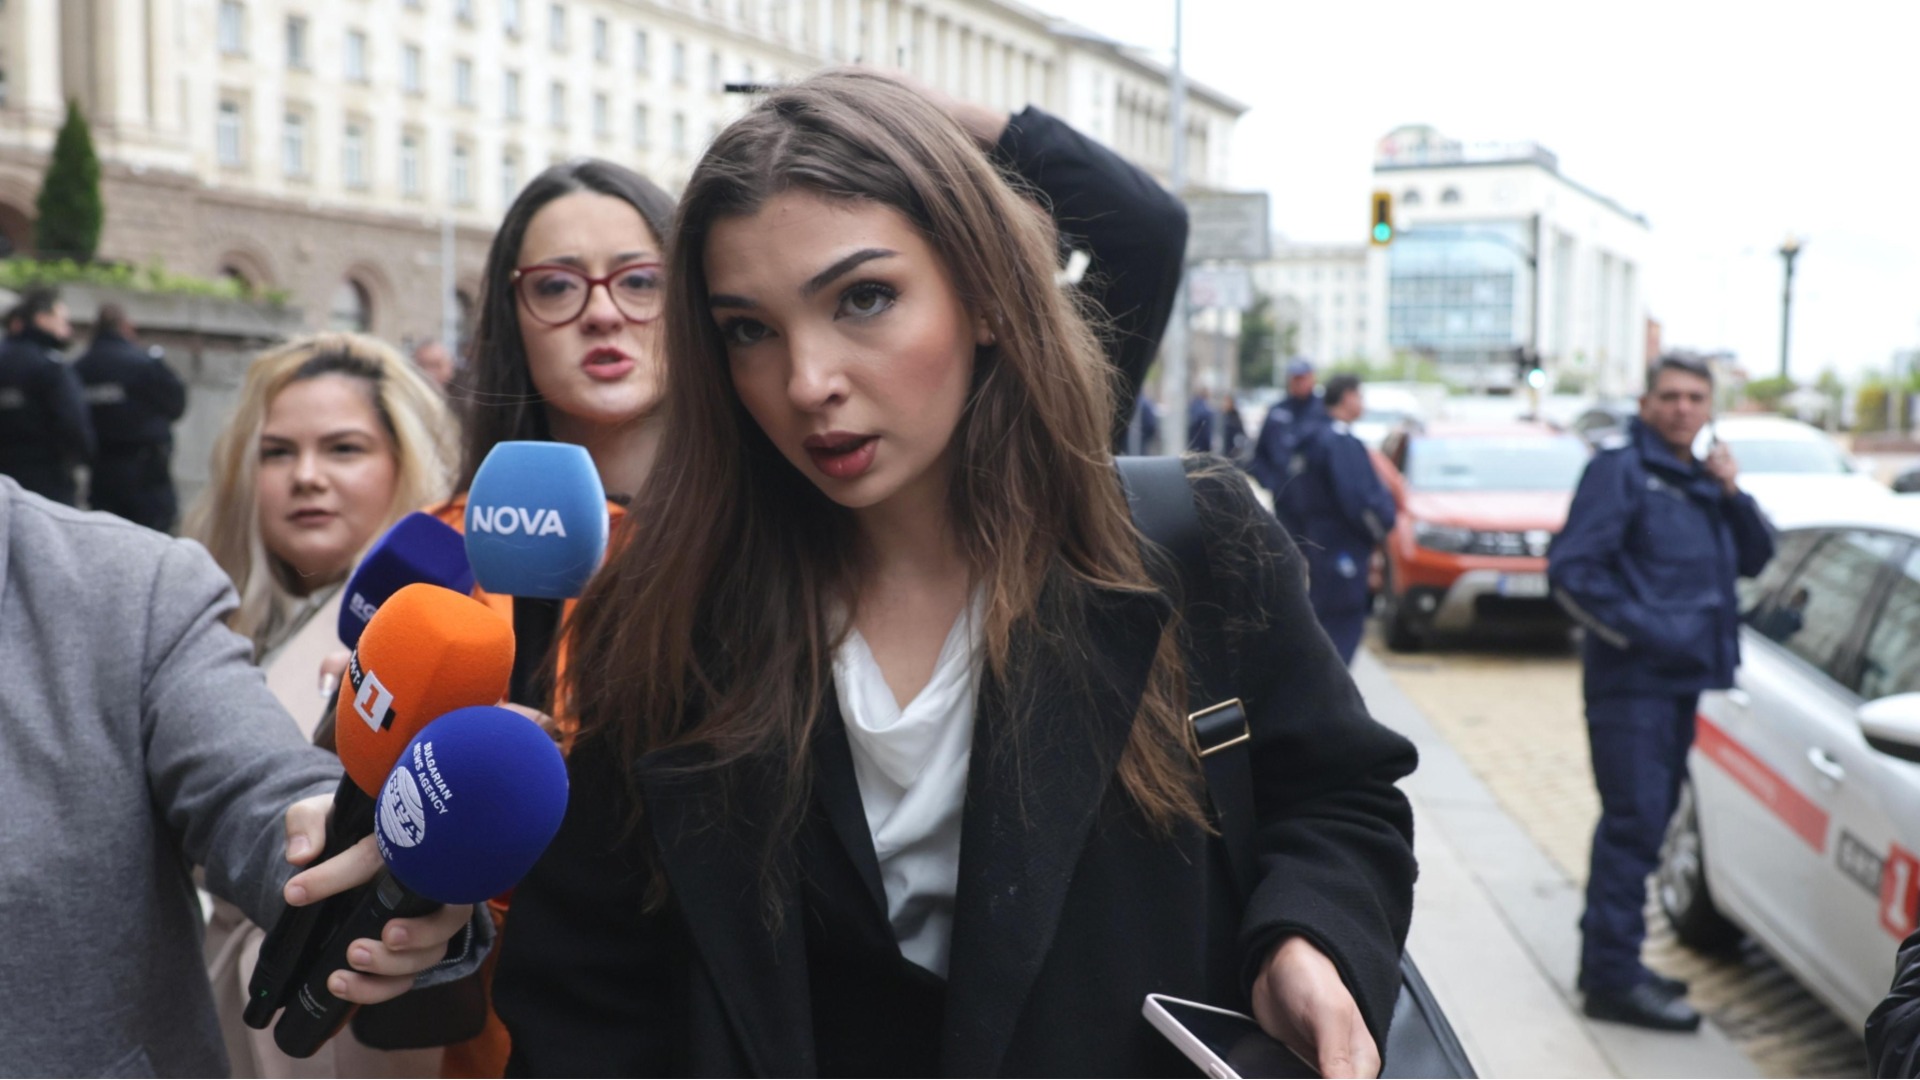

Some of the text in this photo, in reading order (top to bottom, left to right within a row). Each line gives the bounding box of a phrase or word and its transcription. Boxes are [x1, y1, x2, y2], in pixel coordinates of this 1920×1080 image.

[472, 505, 567, 538] NOVA
[360, 683, 380, 718] 1
[413, 741, 449, 815] NEWS AGENCY
[423, 741, 453, 801] BULGARIAN
